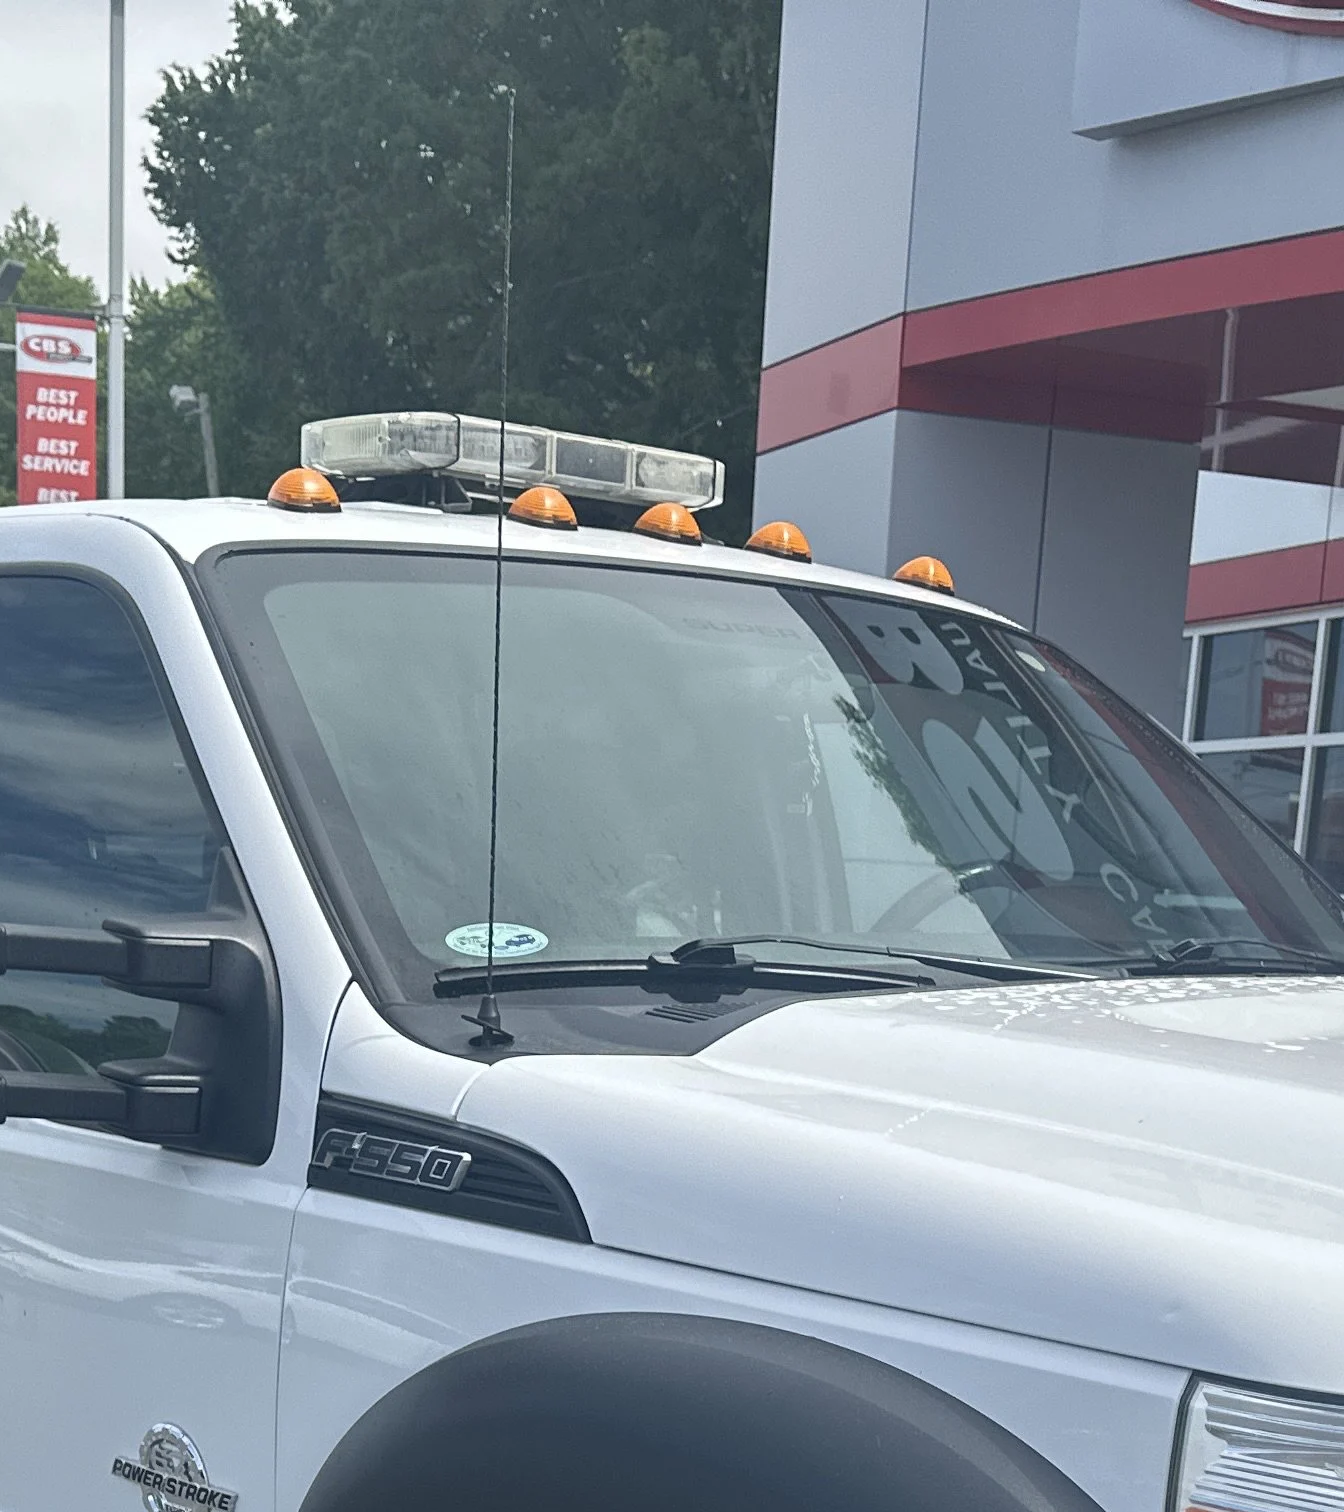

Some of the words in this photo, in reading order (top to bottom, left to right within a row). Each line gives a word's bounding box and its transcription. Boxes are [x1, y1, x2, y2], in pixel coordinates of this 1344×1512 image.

[28, 337, 73, 355] CBS
[36, 387, 79, 406] BEST
[25, 405, 88, 426] PEOPLE
[37, 438, 79, 456] BEST
[21, 454, 91, 477] SERVICE
[37, 488, 80, 504] BEST
[311, 1128, 472, 1191] F-550
[111, 1457, 164, 1491] POWER
[165, 1477, 233, 1511] STROKE
